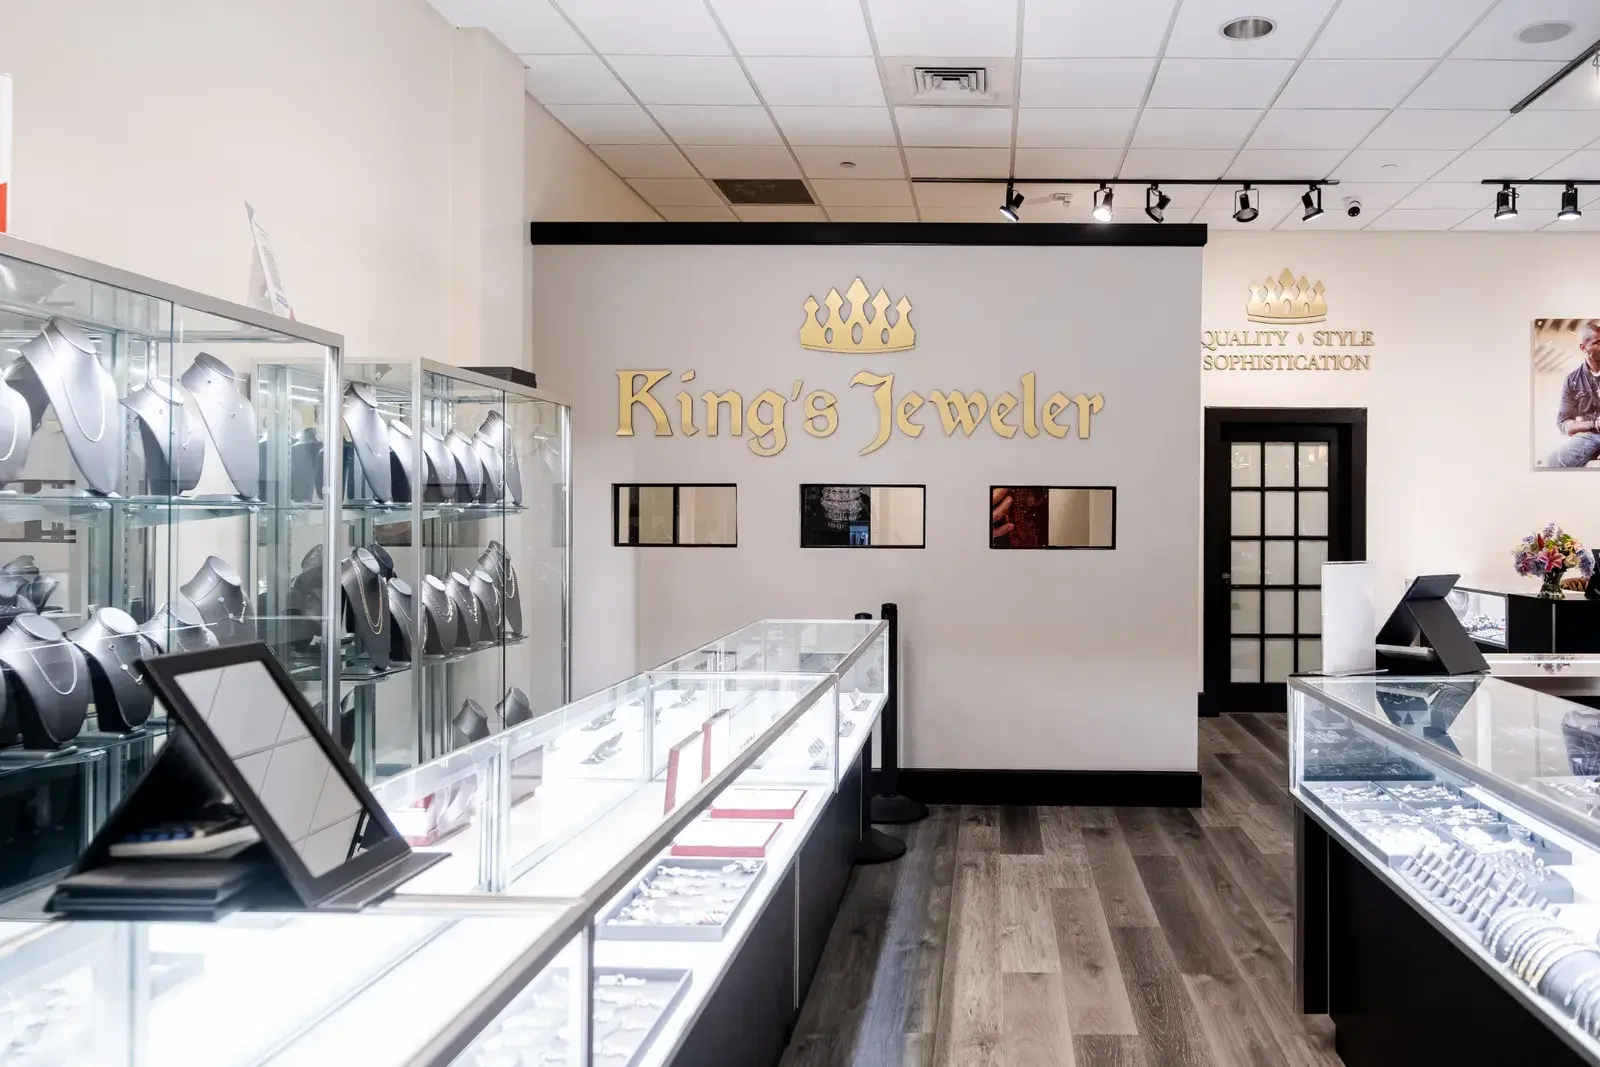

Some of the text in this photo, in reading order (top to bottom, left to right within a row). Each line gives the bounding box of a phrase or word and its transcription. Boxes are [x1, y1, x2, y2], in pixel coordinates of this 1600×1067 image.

[1200, 330, 1375, 351] QUALITY STYLE
[1203, 354, 1371, 371] SOPHISTICATION
[615, 369, 1106, 457] King's Jeweler
